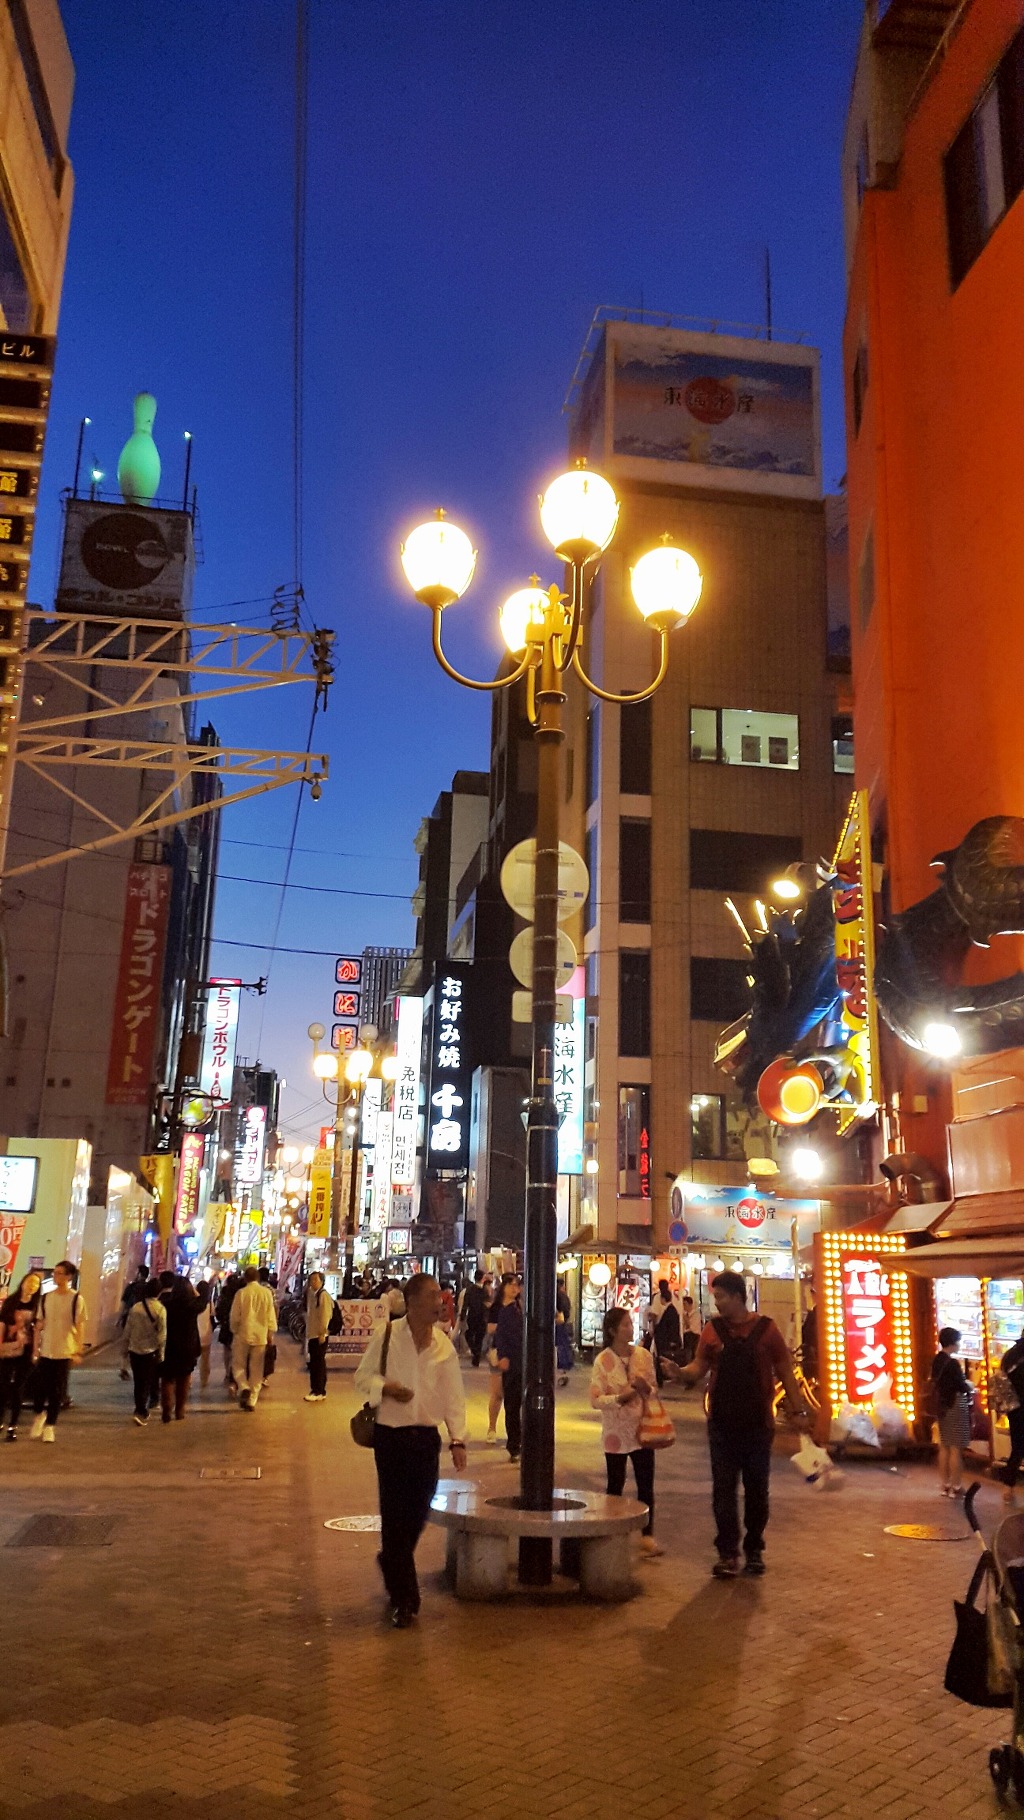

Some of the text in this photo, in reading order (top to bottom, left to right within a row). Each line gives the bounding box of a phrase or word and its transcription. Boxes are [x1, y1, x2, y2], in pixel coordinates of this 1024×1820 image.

[2, 342, 35, 357] ビル
[122, 901, 158, 1083] ドラゴンゲート
[438, 976, 462, 1068] お好み焼
[398, 1065, 416, 1120] 免税店
[852, 1299, 888, 1396] ラーメン
